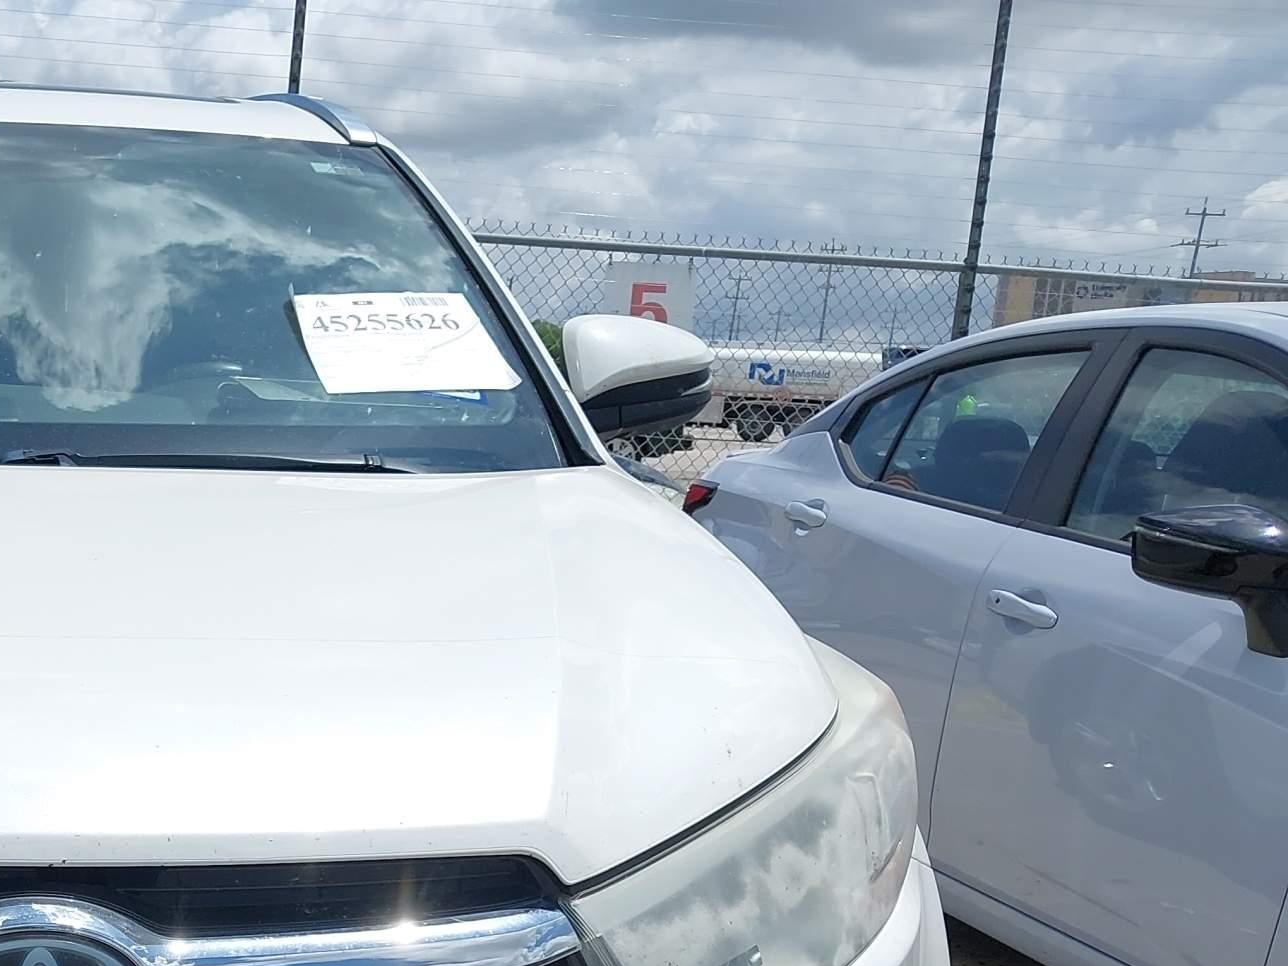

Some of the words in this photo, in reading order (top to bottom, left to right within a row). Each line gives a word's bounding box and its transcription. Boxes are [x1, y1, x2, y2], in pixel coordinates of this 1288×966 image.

[630, 283, 668, 323] 5
[312, 312, 460, 332] 45255626
[786, 368, 831, 379] Mansfield
